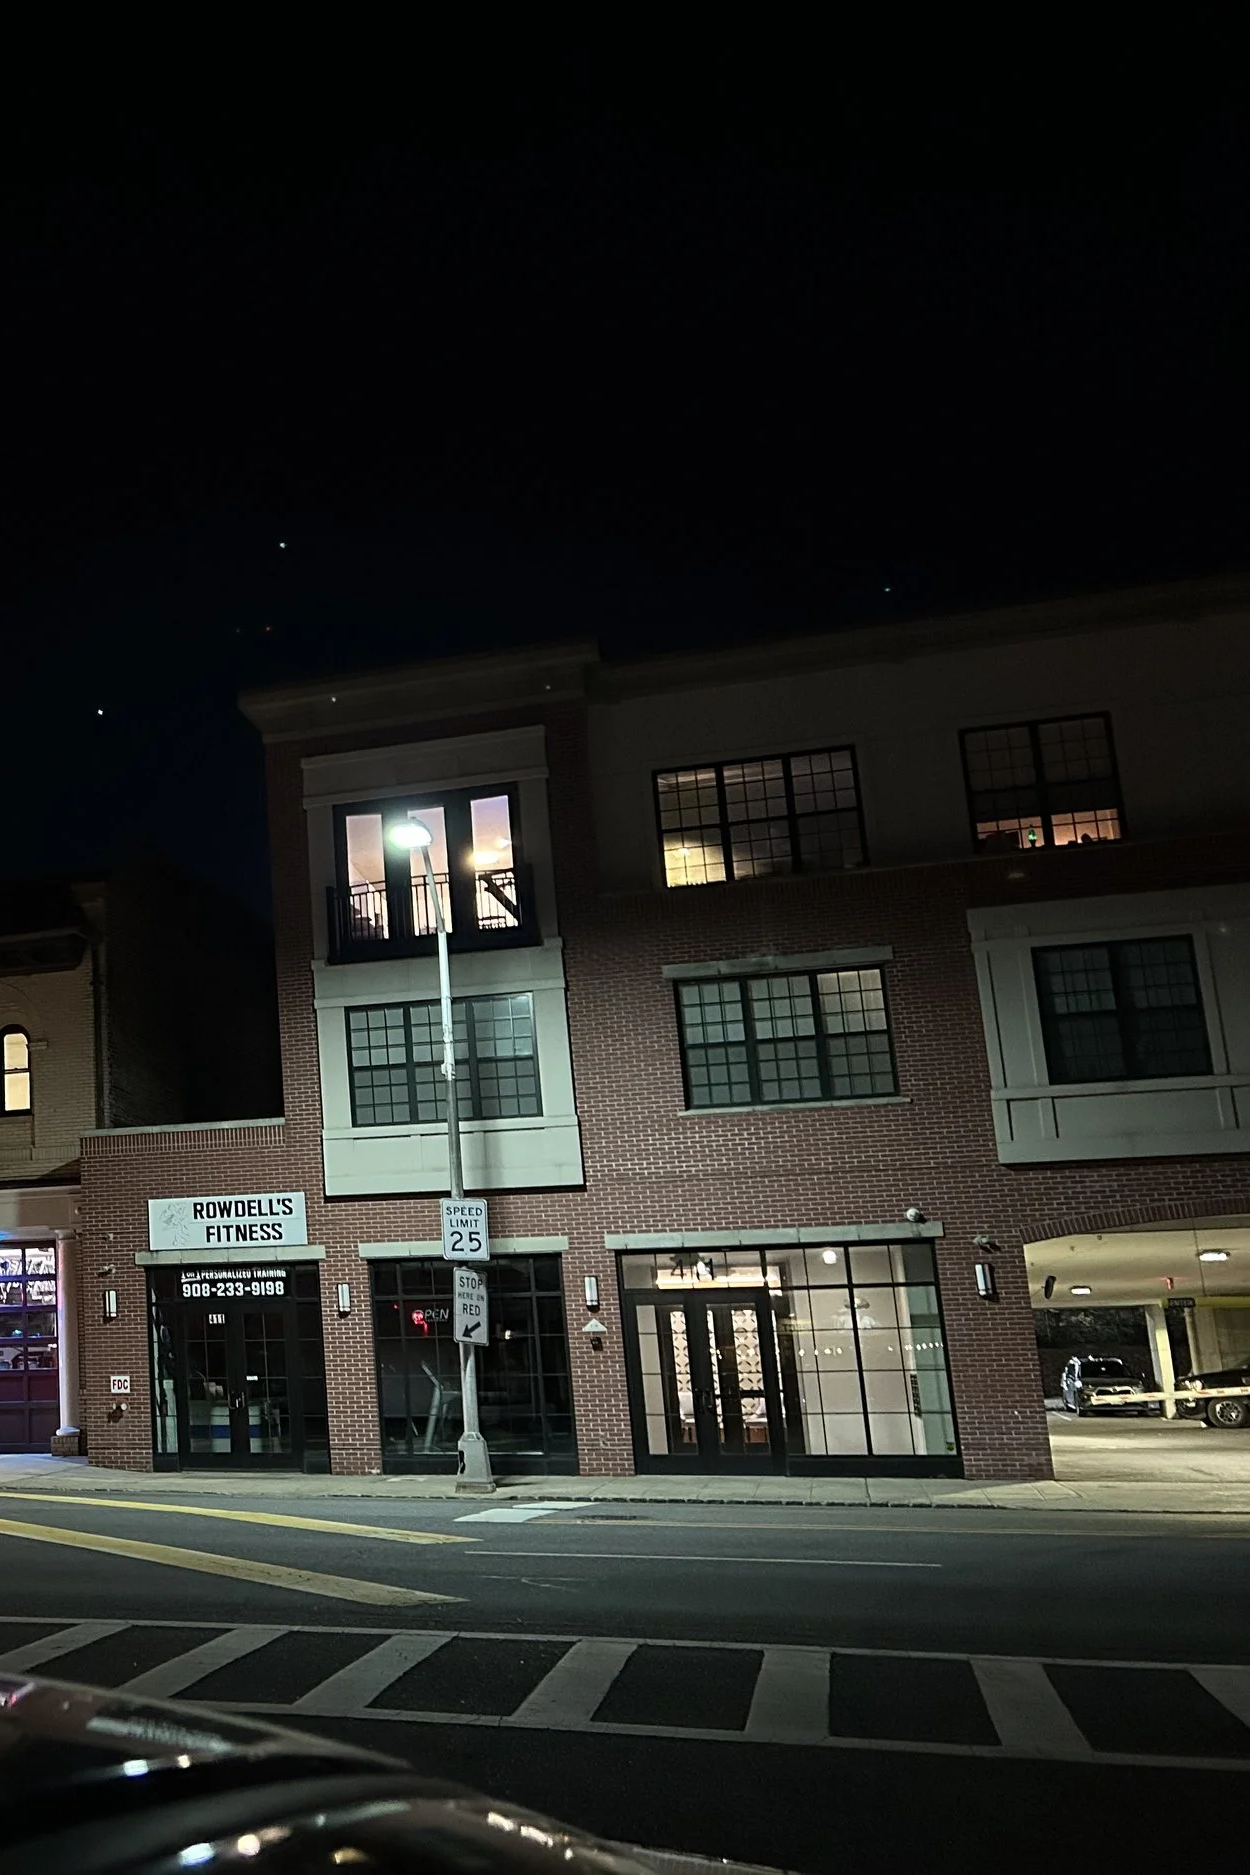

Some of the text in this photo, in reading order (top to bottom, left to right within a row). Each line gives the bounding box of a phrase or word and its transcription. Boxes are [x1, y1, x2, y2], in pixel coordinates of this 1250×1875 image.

[193, 1198, 293, 1220] ROWDELL'S
[446, 1206, 483, 1217] SPEED
[450, 1219, 479, 1228] LIMIT
[206, 1222, 283, 1243] FITNESS
[450, 1231, 482, 1252] 25
[182, 1281, 285, 1298] 908-233-9198
[459, 1276, 483, 1290] STOP
[457, 1291, 485, 1302] HERE ON
[462, 1303, 481, 1316] RED
[112, 1379, 129, 1390] FDC
